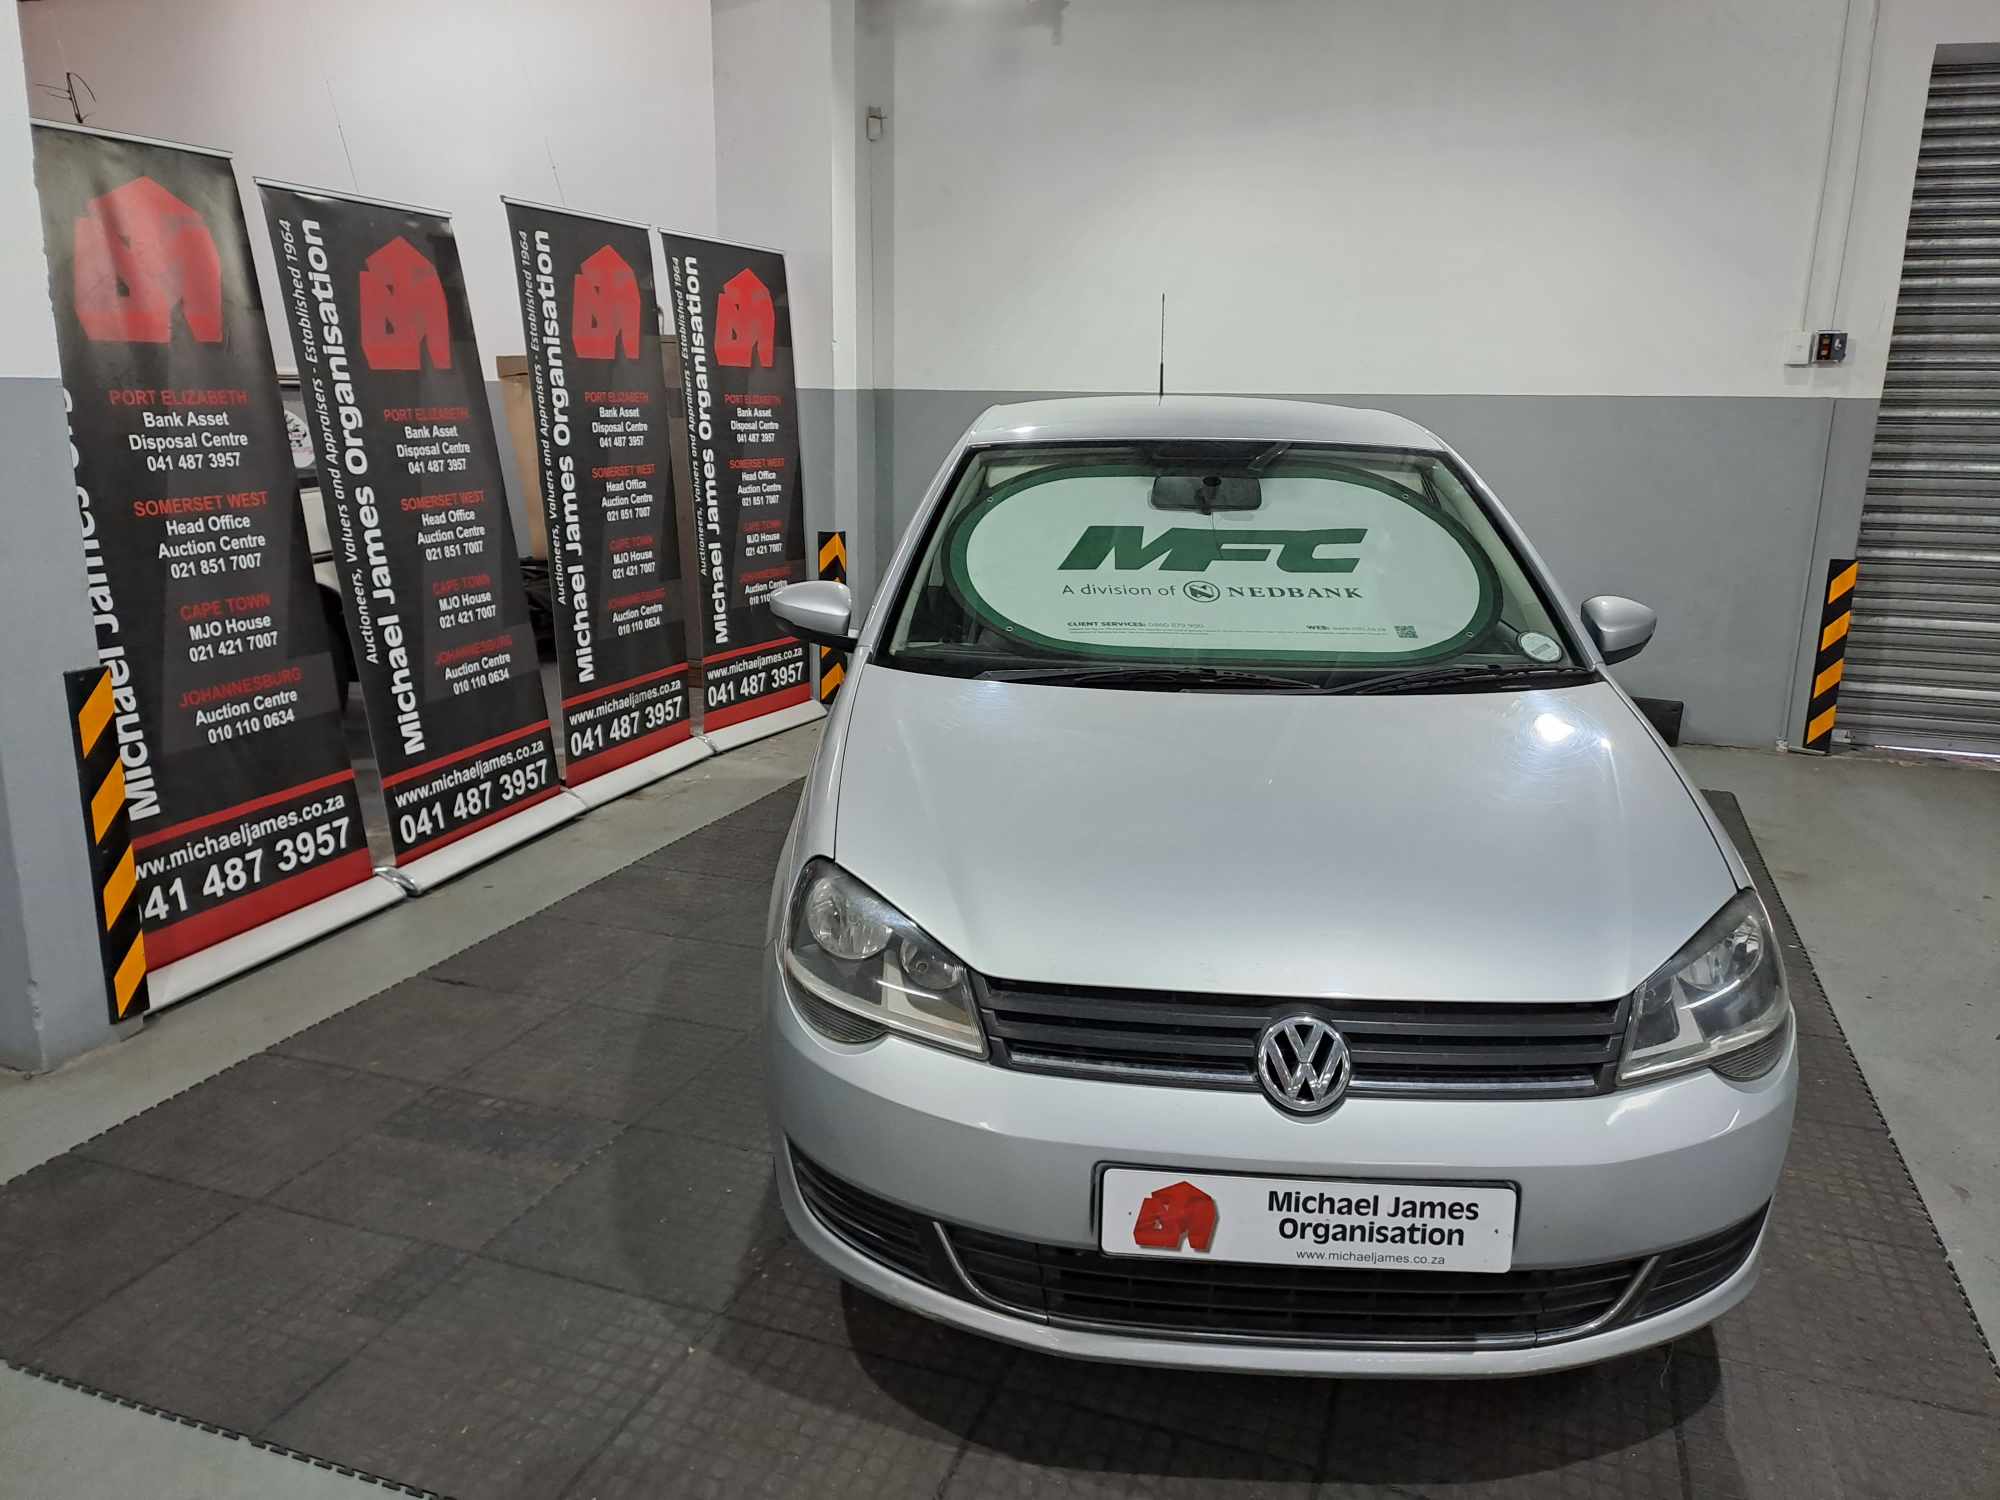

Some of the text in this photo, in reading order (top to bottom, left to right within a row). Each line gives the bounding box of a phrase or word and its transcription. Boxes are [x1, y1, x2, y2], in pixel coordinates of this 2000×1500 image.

[518, 231, 531, 266] 1964
[109, 389, 248, 406] PORT ELIZABETH
[143, 411, 230, 428] Bank Asset
[384, 408, 412, 421] PORT
[599, 407, 640, 418] Bank Asset
[279, 218, 379, 664] Auctioneers, Valuers and Appraisers Established 1964
[405, 425, 458, 439] Bank Asset
[592, 421, 648, 435] Disposal Centre
[128, 431, 248, 452] Disposal Centre
[396, 442, 470, 459] Disposal Centre
[600, 437, 612, 448] 041
[147, 451, 241, 472] 041 487 3957
[408, 458, 466, 474] 041 487 3957
[606, 479, 647, 492] Head Office
[702, 448, 720, 535] James
[134, 491, 268, 517] SOMERSET WEST
[559, 455, 582, 556] James
[601, 493, 653, 508] Auction Centre
[166, 514, 251, 536] Head Office
[422, 509, 475, 527] Head Office
[158, 533, 266, 559] Auction Centre
[355, 485, 396, 605] James
[418, 526, 485, 545] Auction Centre
[426, 541, 483, 561] 021 851 7007
[630, 550, 653, 562] House
[1057, 526, 1368, 573] MFC
[170, 553, 262, 579] 021 851 7007
[612, 568, 625, 580] 021
[626, 565, 638, 577] 421
[439, 592, 491, 611] MJO House
[708, 542, 729, 644] Michael
[1062, 584, 1363, 598] A division of NEDBANK
[180, 593, 272, 620] CAPE TOWN
[439, 605, 496, 629] 021 421 7007
[612, 603, 663, 624] Auction Centre
[189, 616, 271, 641] MJO House
[567, 564, 595, 683] Michael
[189, 631, 278, 662] 021 421 7007
[445, 653, 511, 680] Auction Centre
[707, 647, 803, 680] www.michaeljames.co.za
[179, 667, 303, 709] JOHANNESBURG
[377, 614, 425, 756] Michael
[453, 668, 510, 695] 010 110 0634
[708, 661, 804, 707] 041 487 3957
[195, 690, 298, 726] Auction Centre
[569, 679, 681, 726] www.michaeljames.co.za
[208, 708, 295, 744] 010 110 0634
[570, 695, 682, 757] 041 487 3957
[395, 740, 544, 808] www.michaeljames.co.za
[400, 758, 548, 844] 041 487 3957
[136, 795, 345, 880] ww.michaeljames.co.za
[138, 816, 349, 923] 41 487 3957
[1268, 1190, 1480, 1221] Michael James
[1278, 1217, 1465, 1246] Organisation
[1296, 1249, 1445, 1266] www.michaeljames.co.za
